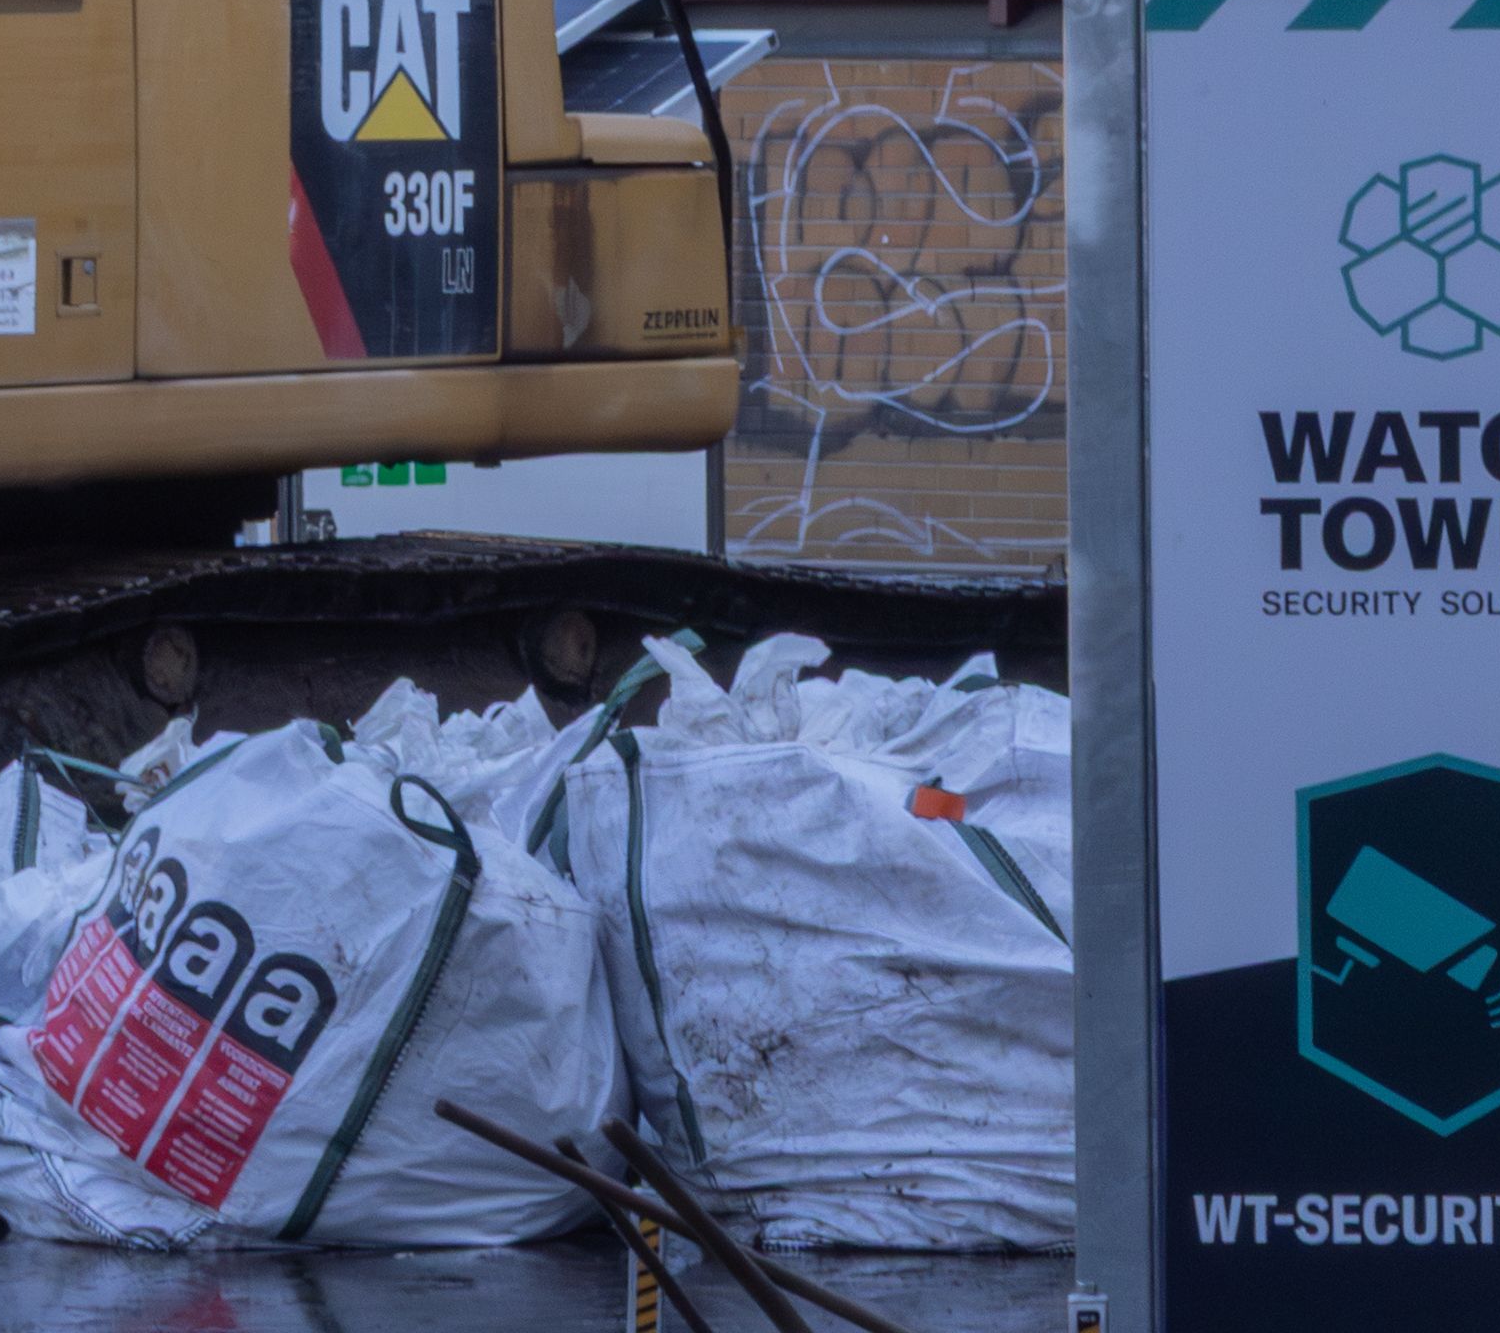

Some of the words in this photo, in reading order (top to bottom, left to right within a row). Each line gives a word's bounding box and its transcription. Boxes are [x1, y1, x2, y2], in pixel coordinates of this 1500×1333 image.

[383, 169, 475, 237] 330F
[441, 246, 475, 294] LN
[643, 308, 720, 330] ZEPPELIN
[1262, 590, 1422, 617] SECURITY
